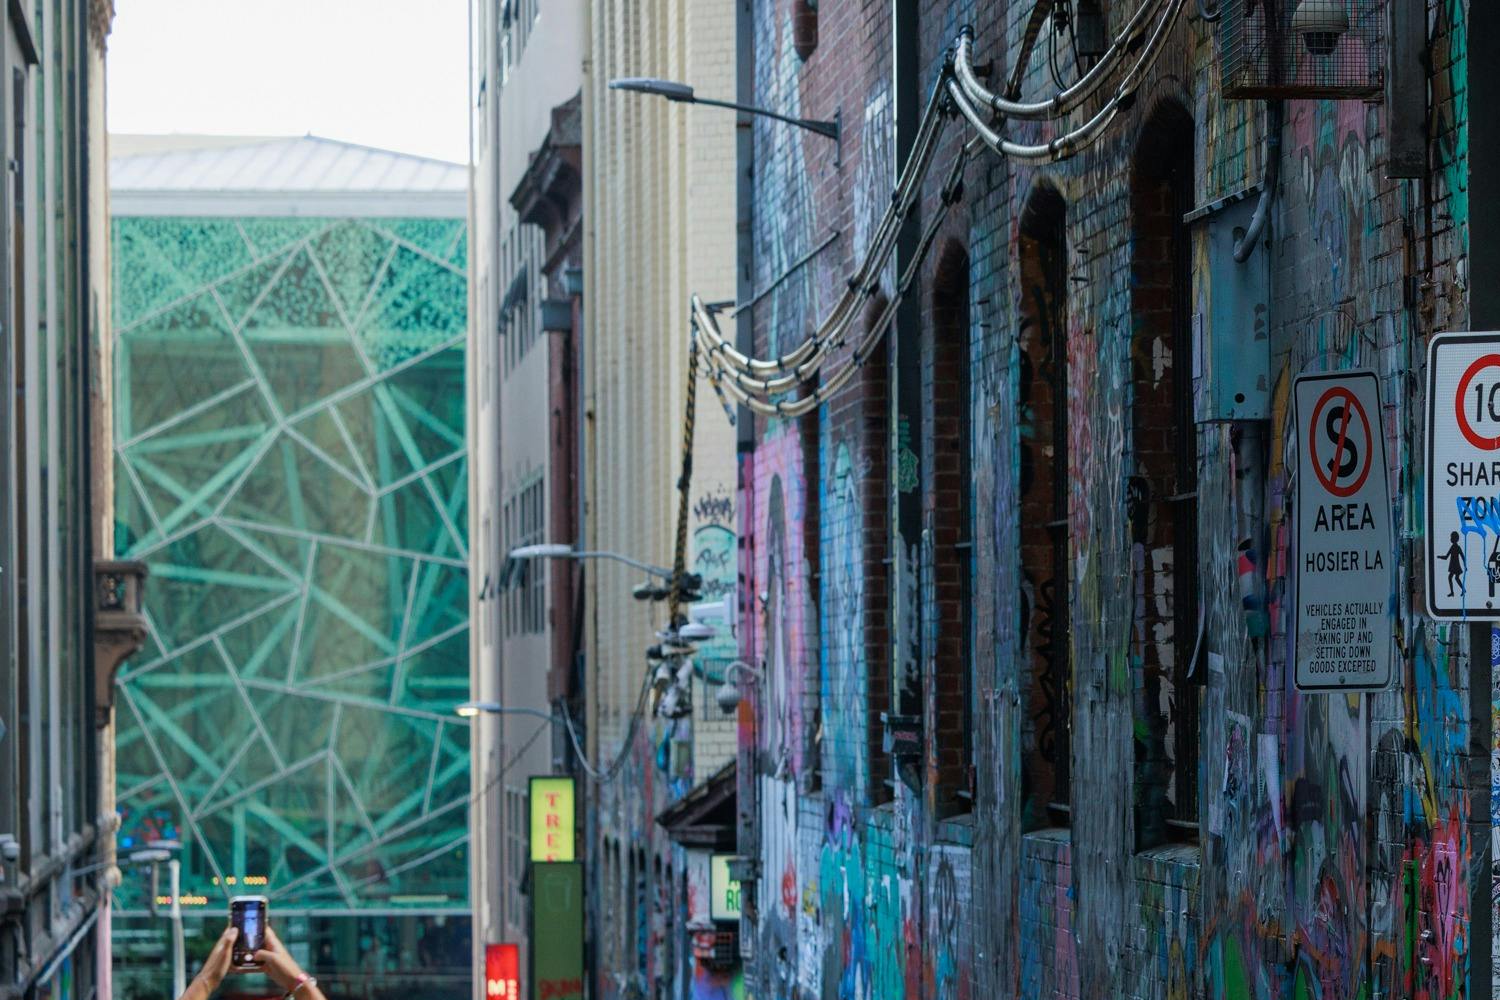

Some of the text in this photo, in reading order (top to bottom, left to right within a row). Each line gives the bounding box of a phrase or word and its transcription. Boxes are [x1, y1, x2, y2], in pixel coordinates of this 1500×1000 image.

[1314, 502, 1376, 532] AREA
[1306, 549, 1384, 573] HOSIER LA
[1306, 602, 1384, 616] VEHICLES ACTUALLY
[1321, 617, 1367, 631] ENGAGED IN
[1314, 631, 1373, 645] TAKING UP AND
[1315, 645, 1371, 659] SETTING DOWN
[1309, 660, 1377, 674] GOODS EXCEPTED
[544, 792, 561, 863] TRE
